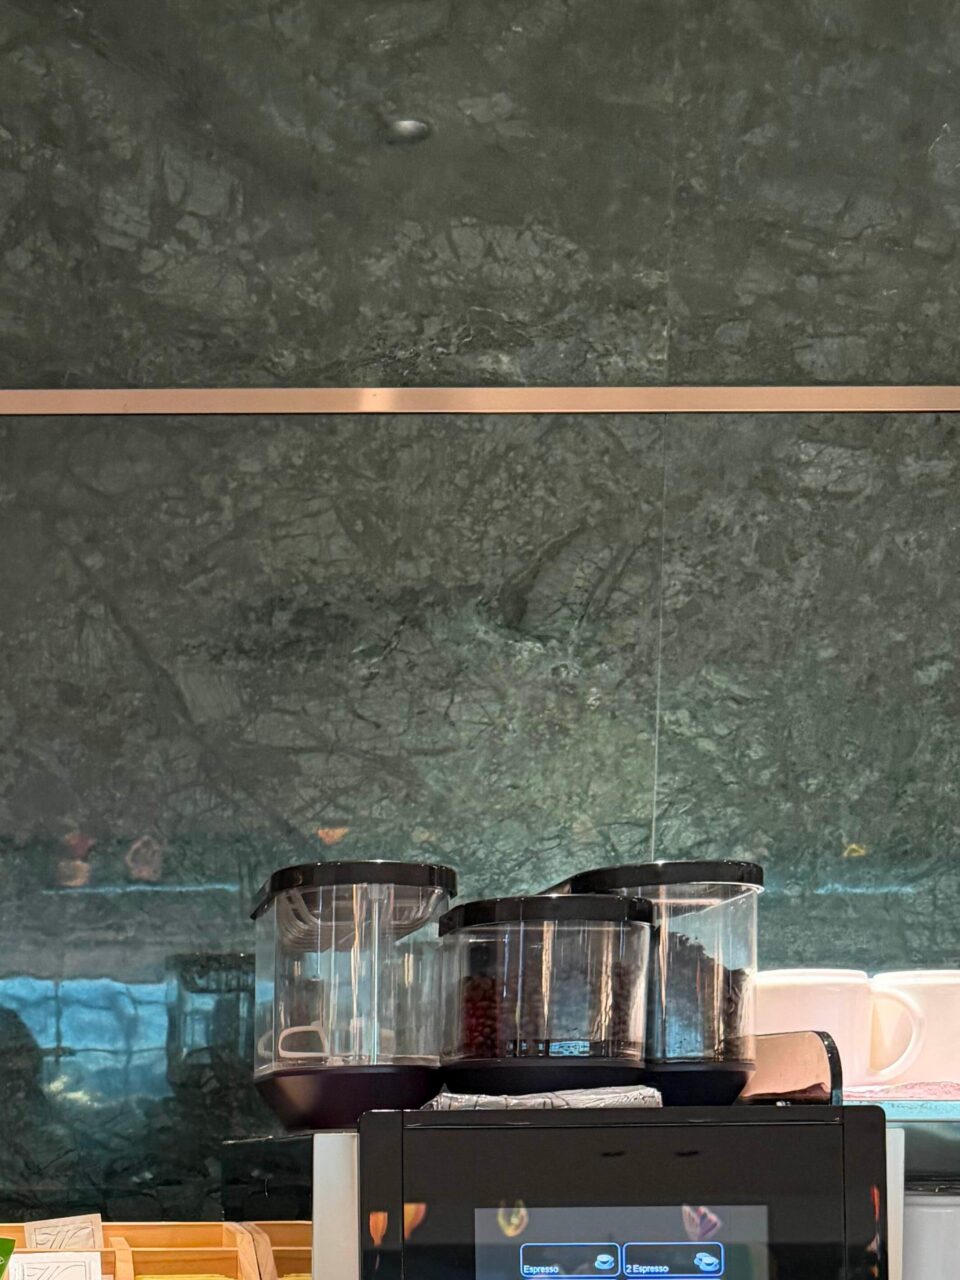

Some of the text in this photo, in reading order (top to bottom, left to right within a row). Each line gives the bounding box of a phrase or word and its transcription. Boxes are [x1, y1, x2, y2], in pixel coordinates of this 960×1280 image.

[523, 1265, 559, 1274] Espresso
[626, 1265, 669, 1274] 2 Espresso
